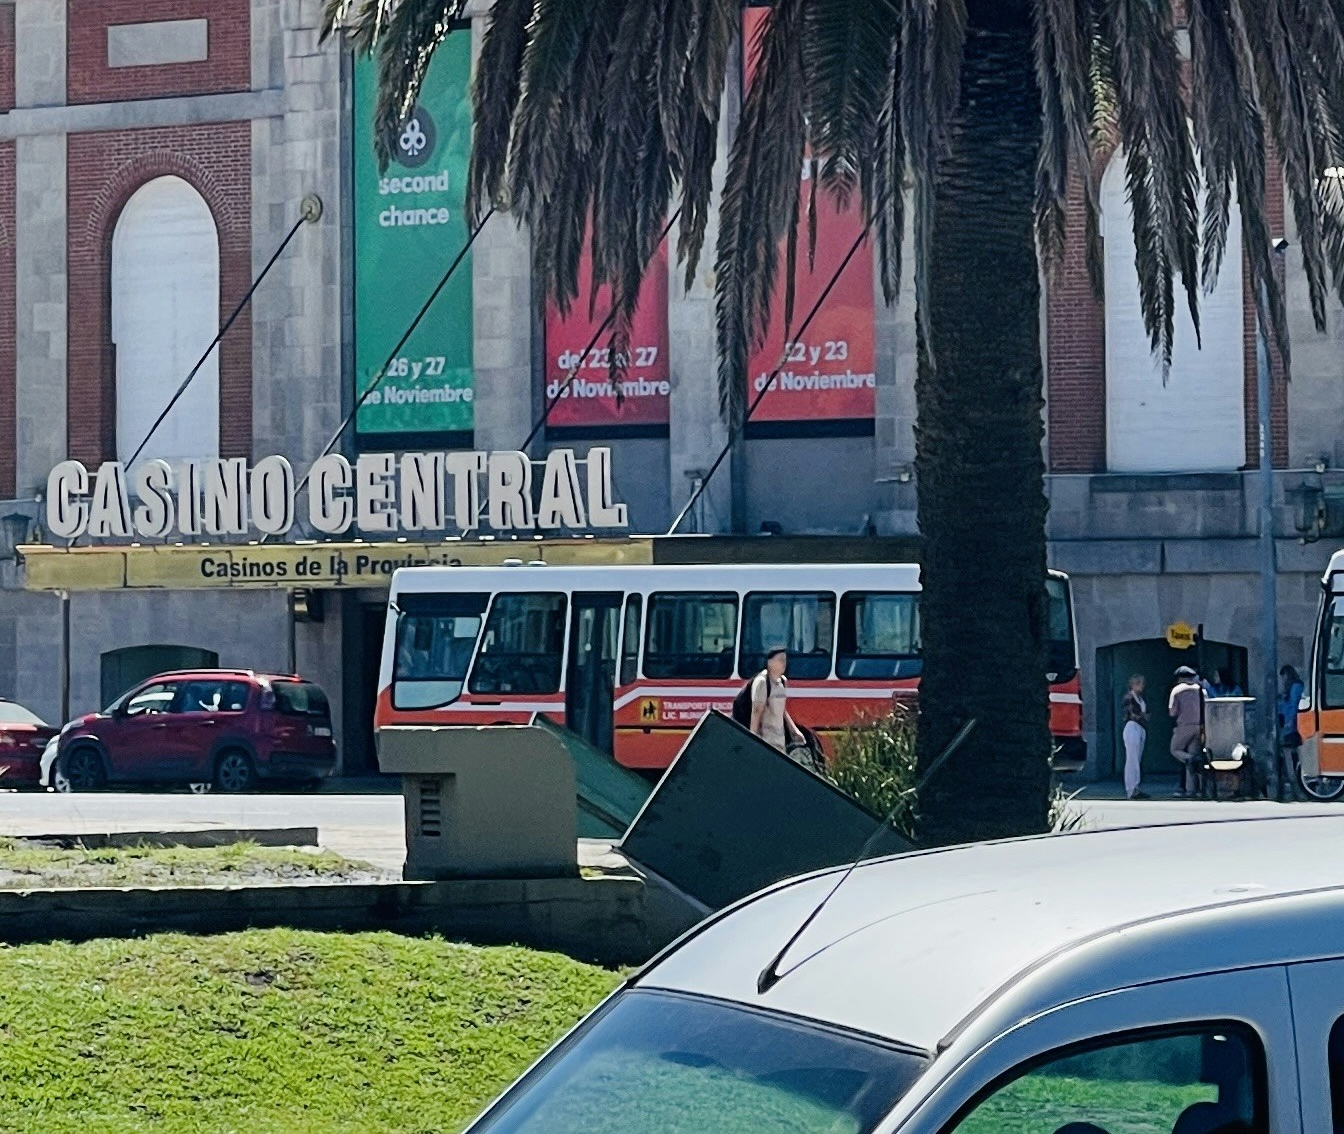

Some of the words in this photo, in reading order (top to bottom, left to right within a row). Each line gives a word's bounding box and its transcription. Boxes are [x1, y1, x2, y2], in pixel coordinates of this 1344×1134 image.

[378, 170, 449, 195] second
[378, 205, 450, 227] chance
[635, 347, 658, 367] 27
[809, 346, 821, 366] y
[824, 341, 848, 361] 23
[387, 357, 409, 377] 26
[411, 362, 423, 382] y
[425, 357, 446, 376] 27
[384, 384, 474, 404] Noviembre
[573, 377, 670, 398] Novimbre
[46, 454, 295, 538] CASINO
[308, 446, 629, 533] CENTRAL
[200, 557, 288, 578] Casinos
[294, 555, 322, 576] de
[330, 555, 349, 575] la
